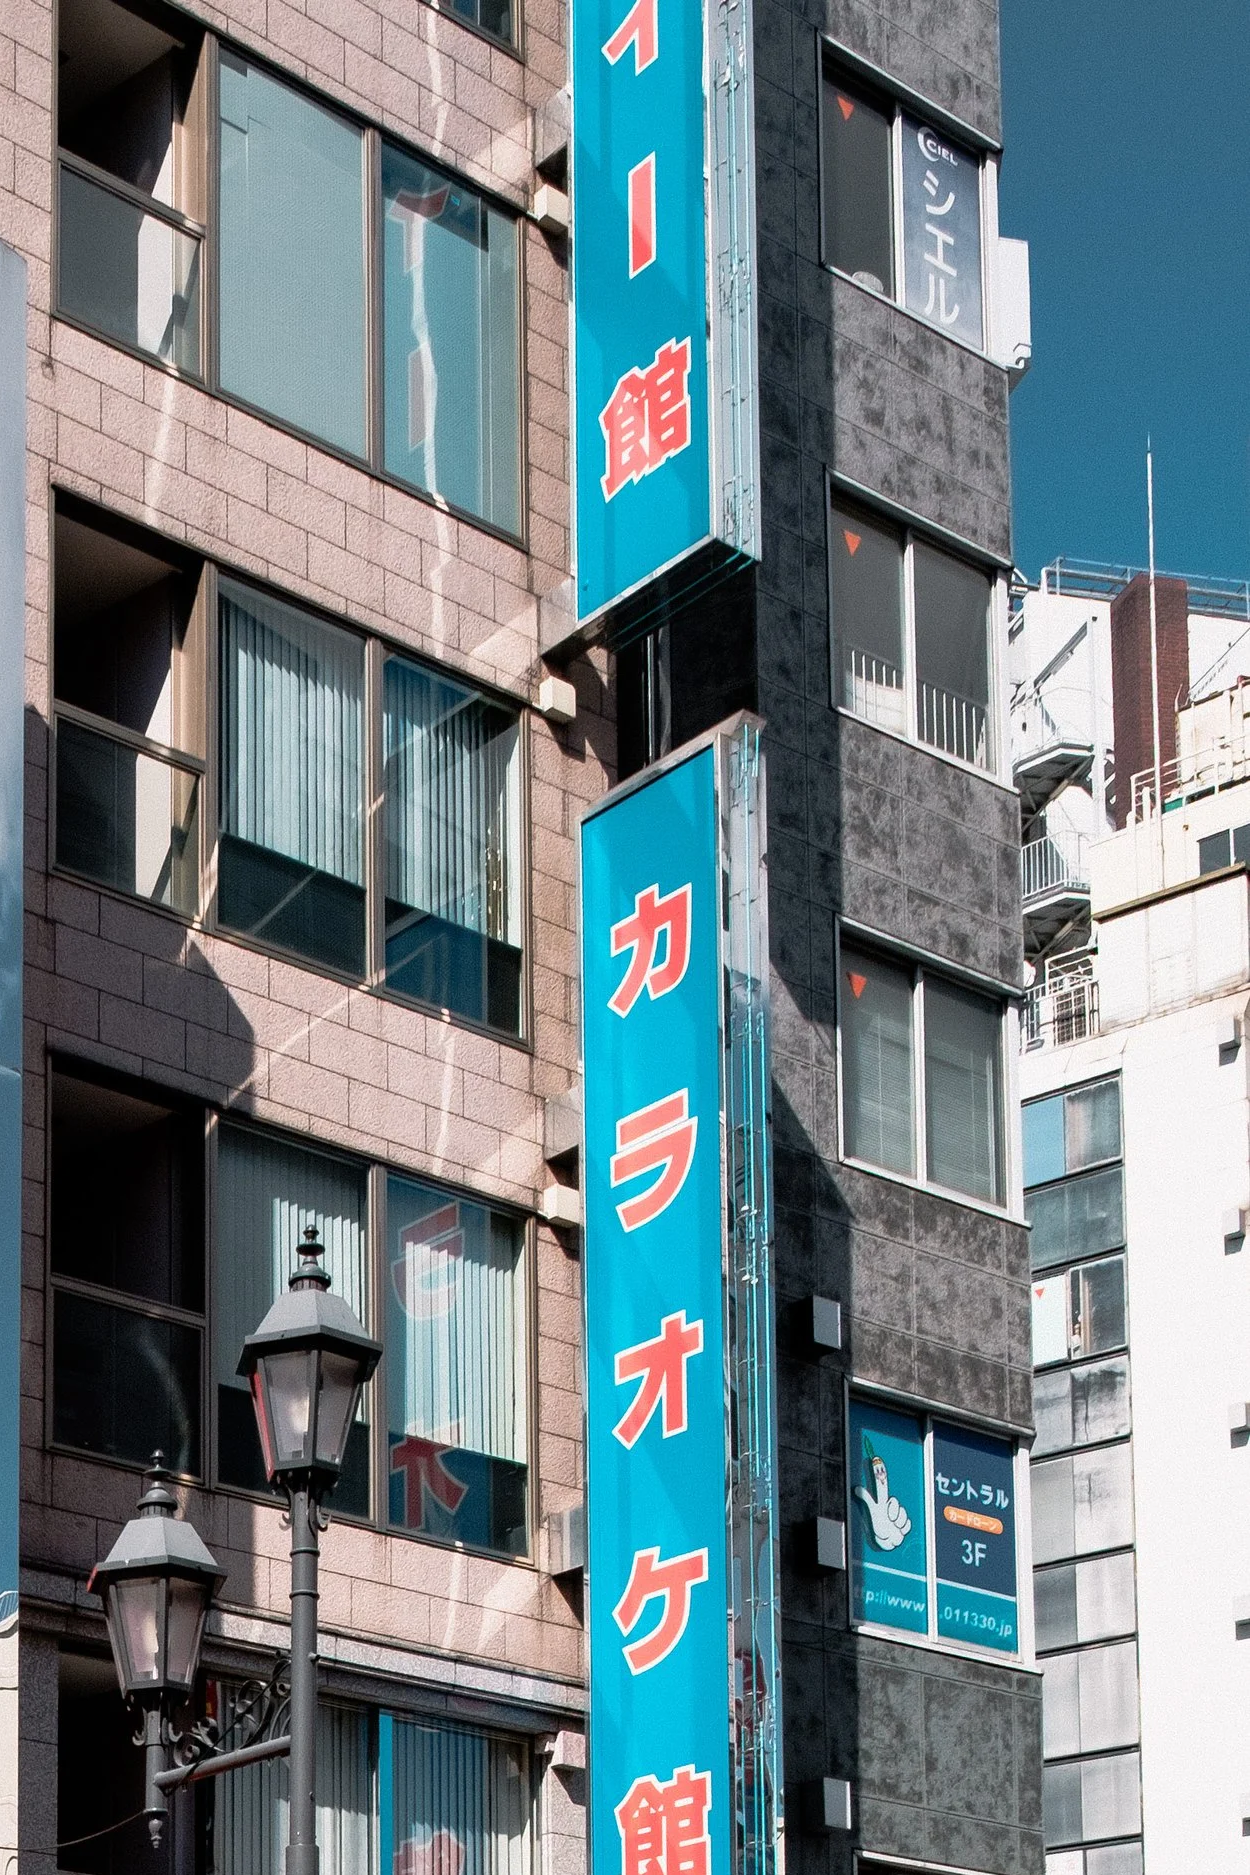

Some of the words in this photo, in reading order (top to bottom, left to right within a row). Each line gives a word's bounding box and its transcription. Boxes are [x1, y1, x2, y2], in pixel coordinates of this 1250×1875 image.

[925, 138, 959, 167] CIEL
[923, 169, 960, 325] シエル
[935, 1472, 1009, 1510] セントラル
[948, 1509, 998, 1532] カードローン
[961, 1539, 987, 1567] 3F
